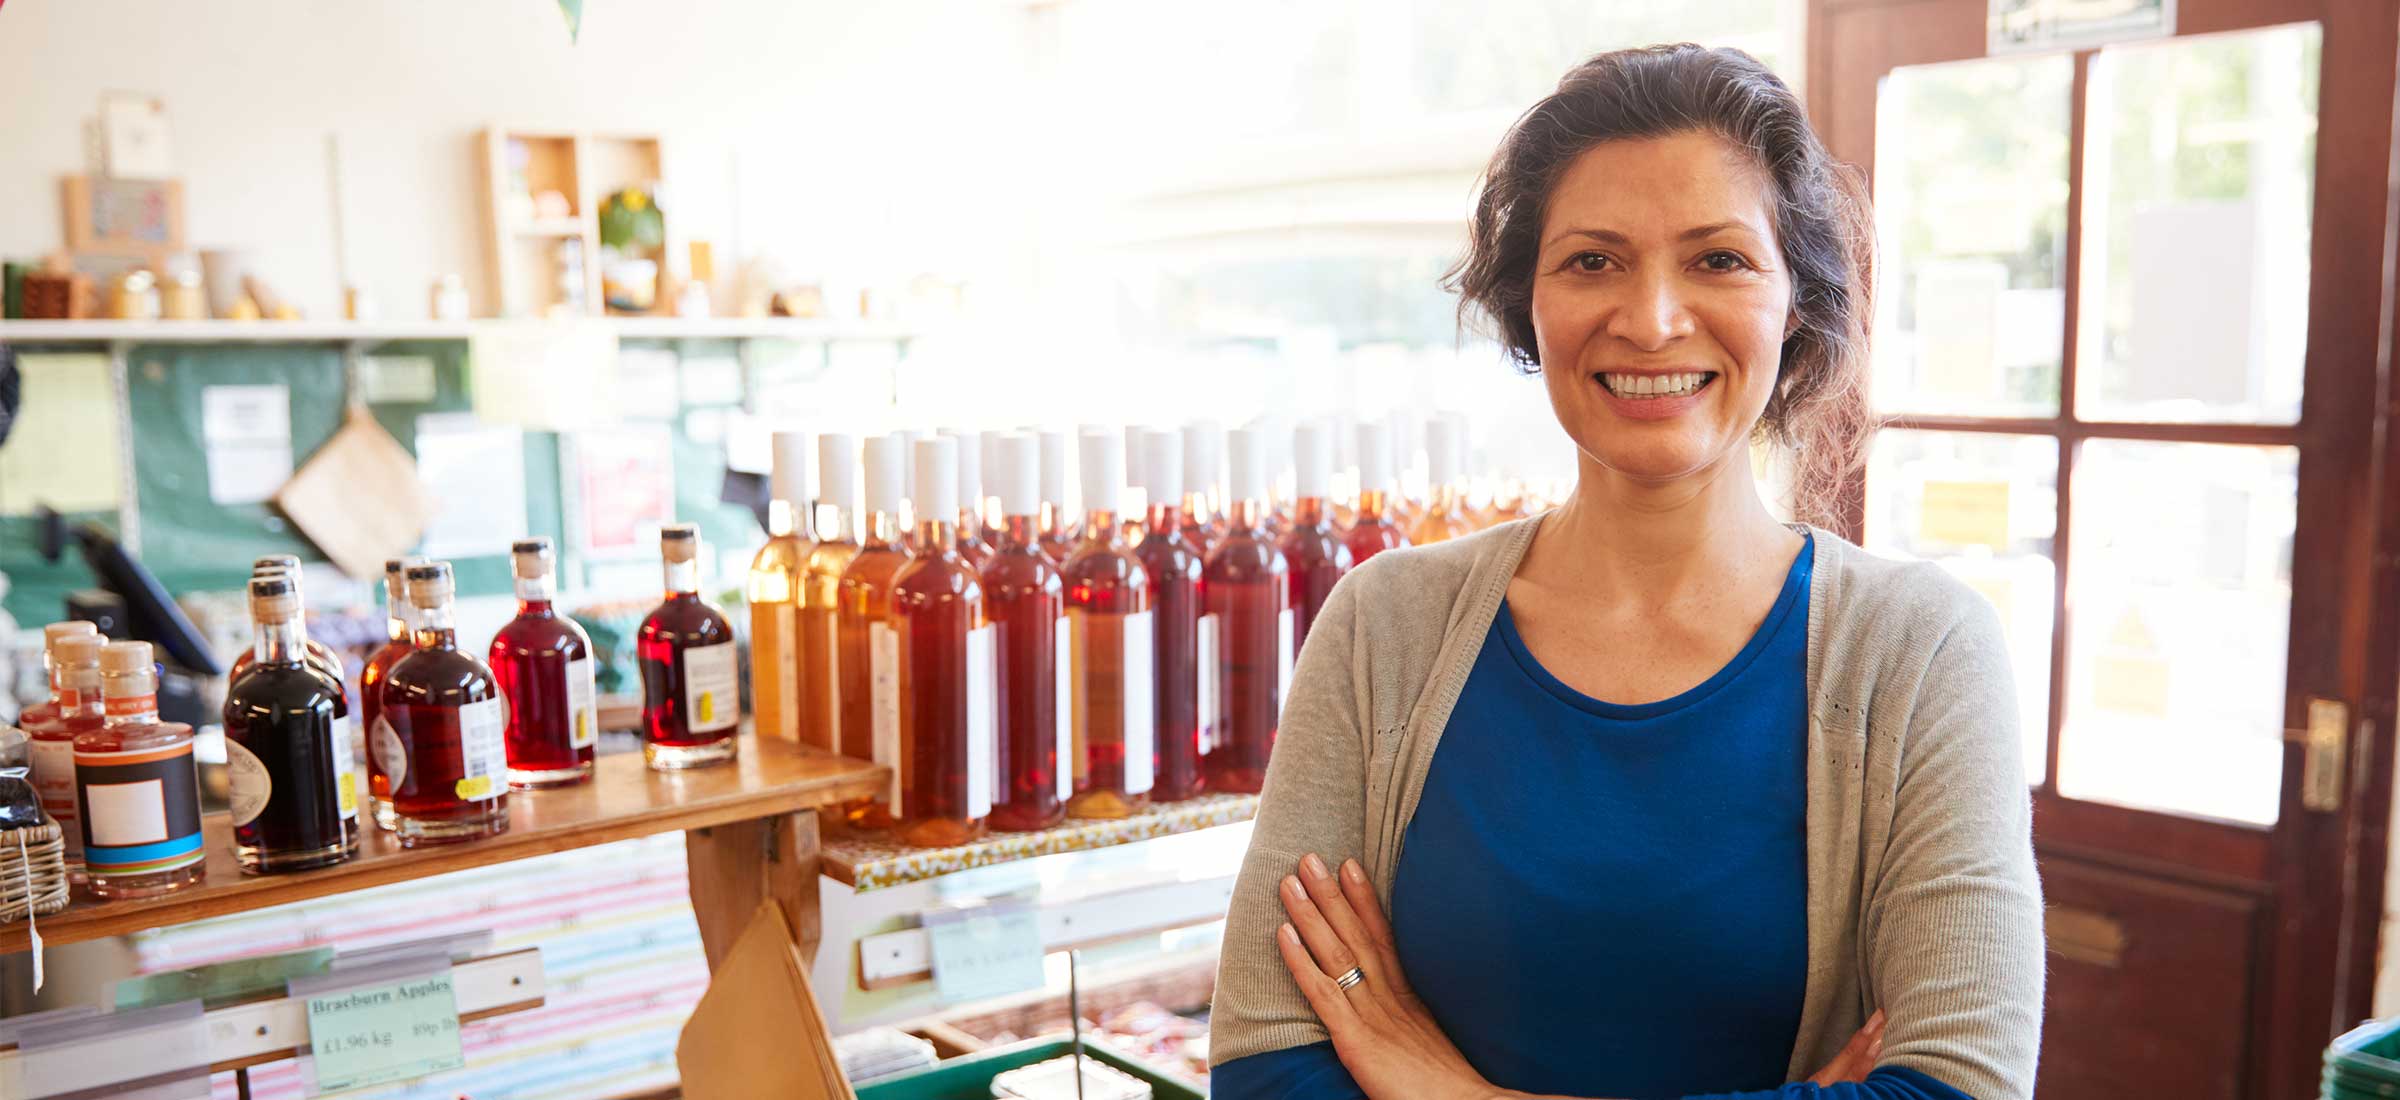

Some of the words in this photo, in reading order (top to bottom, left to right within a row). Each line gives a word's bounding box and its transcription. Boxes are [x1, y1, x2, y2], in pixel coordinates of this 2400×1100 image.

[312, 991, 391, 1014] Braeburn
[398, 980, 450, 999] Apples
[371, 1030, 393, 1047] kg
